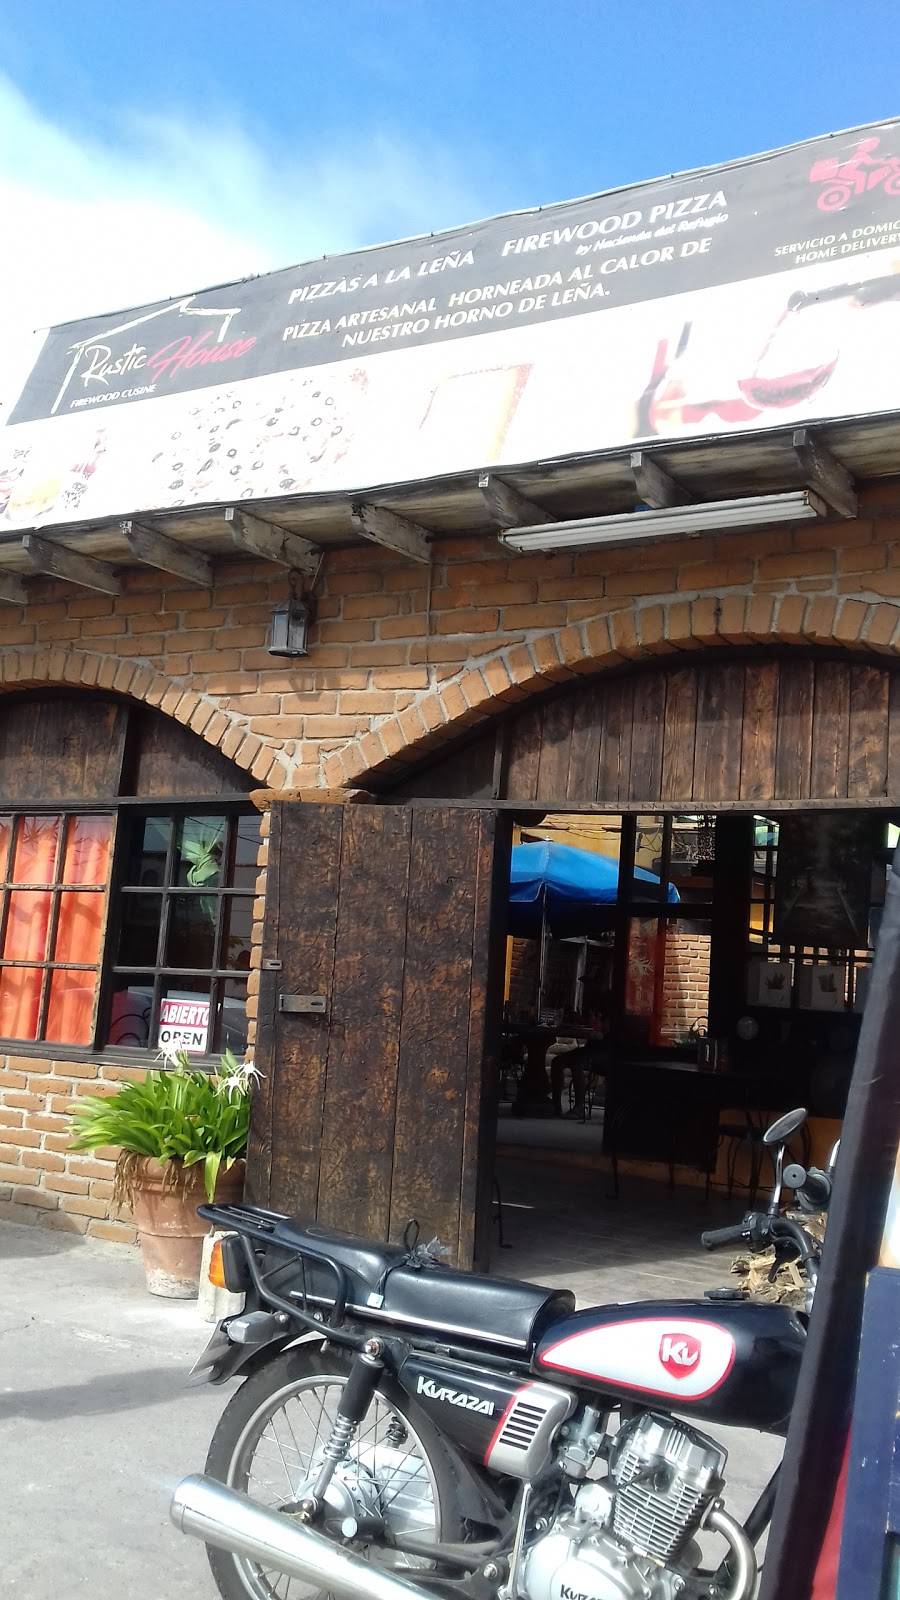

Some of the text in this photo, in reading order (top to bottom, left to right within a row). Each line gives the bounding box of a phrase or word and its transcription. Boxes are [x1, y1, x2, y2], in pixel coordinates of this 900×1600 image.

[502, 190, 727, 256] FIREWOOD PIZZA
[576, 244, 592, 255] by
[774, 235, 835, 256] SERVICIO
[838, 232, 848, 241] A
[795, 247, 837, 264] HOME
[282, 238, 713, 341] PIZZA ARTESANAL HORNEADA AL CALOR DE
[288, 250, 475, 304] PIZZAS A LA LEÑA
[342, 282, 610, 347] NUESTRO HORNO DE LEÑA.
[81, 330, 257, 387] Rustic House
[70, 392, 120, 408] FIREWOOD
[161, 1030, 203, 1046] OPEN
